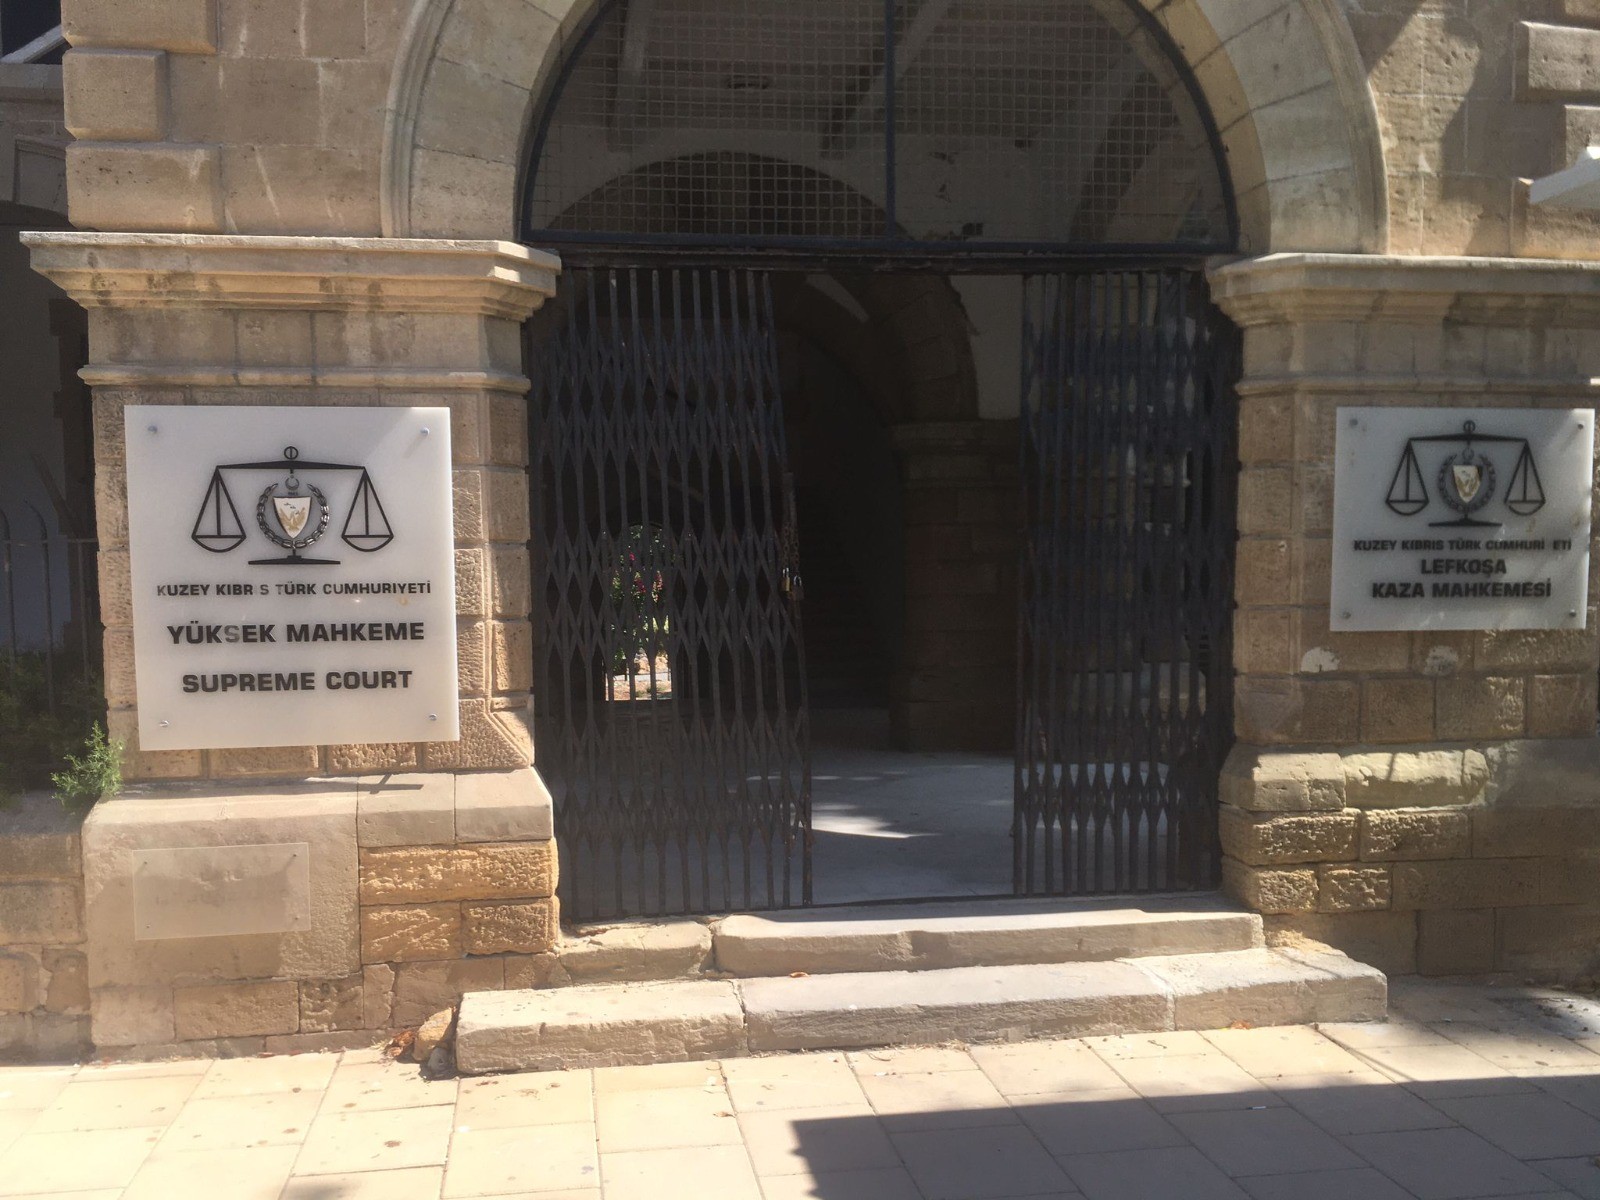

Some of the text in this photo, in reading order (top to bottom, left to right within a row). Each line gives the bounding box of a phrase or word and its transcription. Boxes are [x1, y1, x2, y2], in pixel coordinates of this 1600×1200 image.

[1353, 539, 1397, 551] KUZEY
[1401, 539, 1444, 550] KIBRIS
[1448, 537, 1481, 550] TÜRK
[1421, 559, 1507, 578] LEFKOŞA
[157, 583, 211, 597] KUZEY
[216, 583, 270, 597] KIBRS
[275, 580, 317, 596] TÜRK
[1372, 578, 1552, 598] KAZA MAHKEMESİ
[167, 620, 425, 645] YÜKSEK MAHKEME
[182, 670, 413, 693] SUPREME COURT
